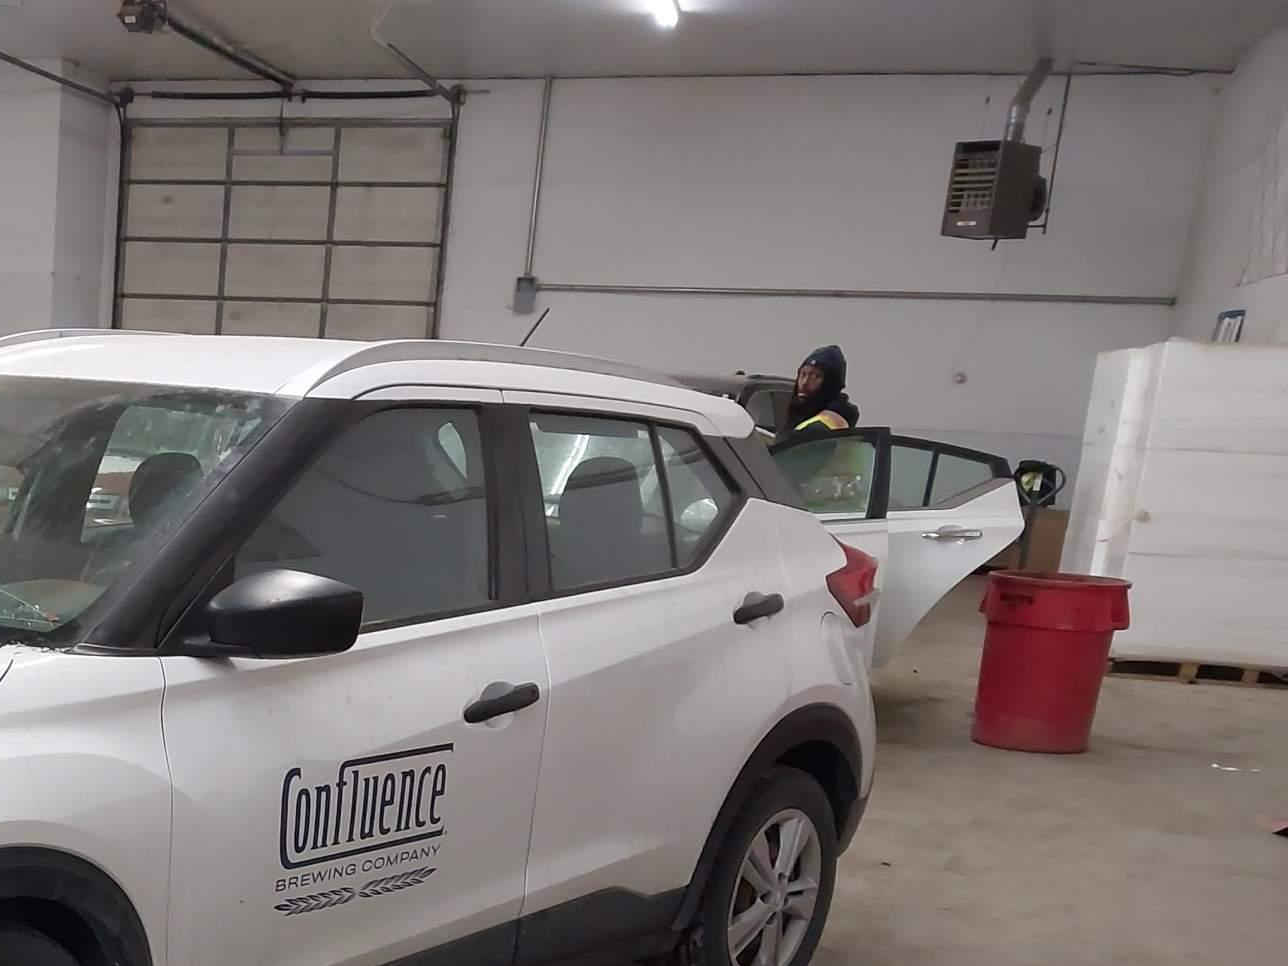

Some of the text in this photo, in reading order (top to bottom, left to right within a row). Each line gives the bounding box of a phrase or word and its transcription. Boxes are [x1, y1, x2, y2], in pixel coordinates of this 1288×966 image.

[280, 743, 454, 870] Confluence
[275, 844, 442, 893] BREWING COMPANY
